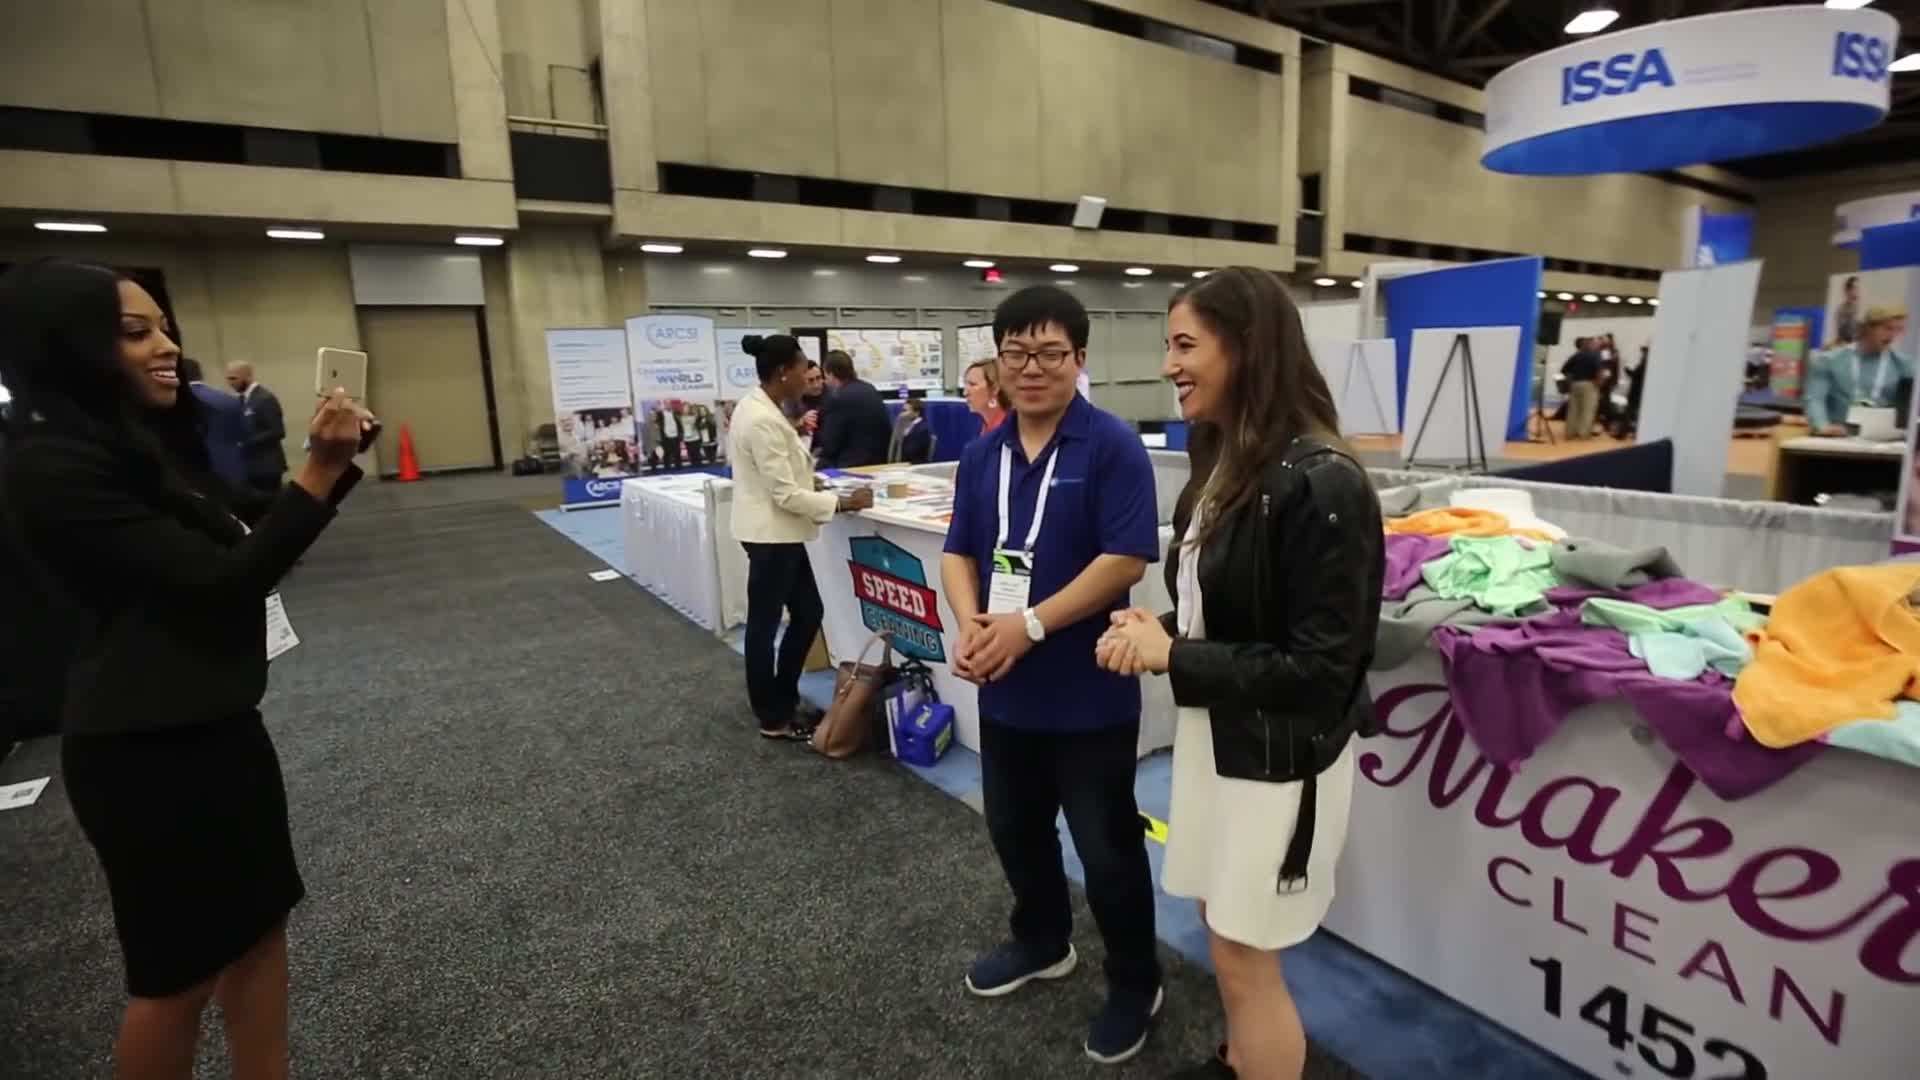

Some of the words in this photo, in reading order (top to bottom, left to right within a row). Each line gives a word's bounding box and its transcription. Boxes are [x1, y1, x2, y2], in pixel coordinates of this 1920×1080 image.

[1561, 48, 1675, 106] ISSA
[1833, 31, 1888, 82] ISS
[862, 571, 926, 619] SPEED
[1487, 856, 1846, 1048] CLEAN
